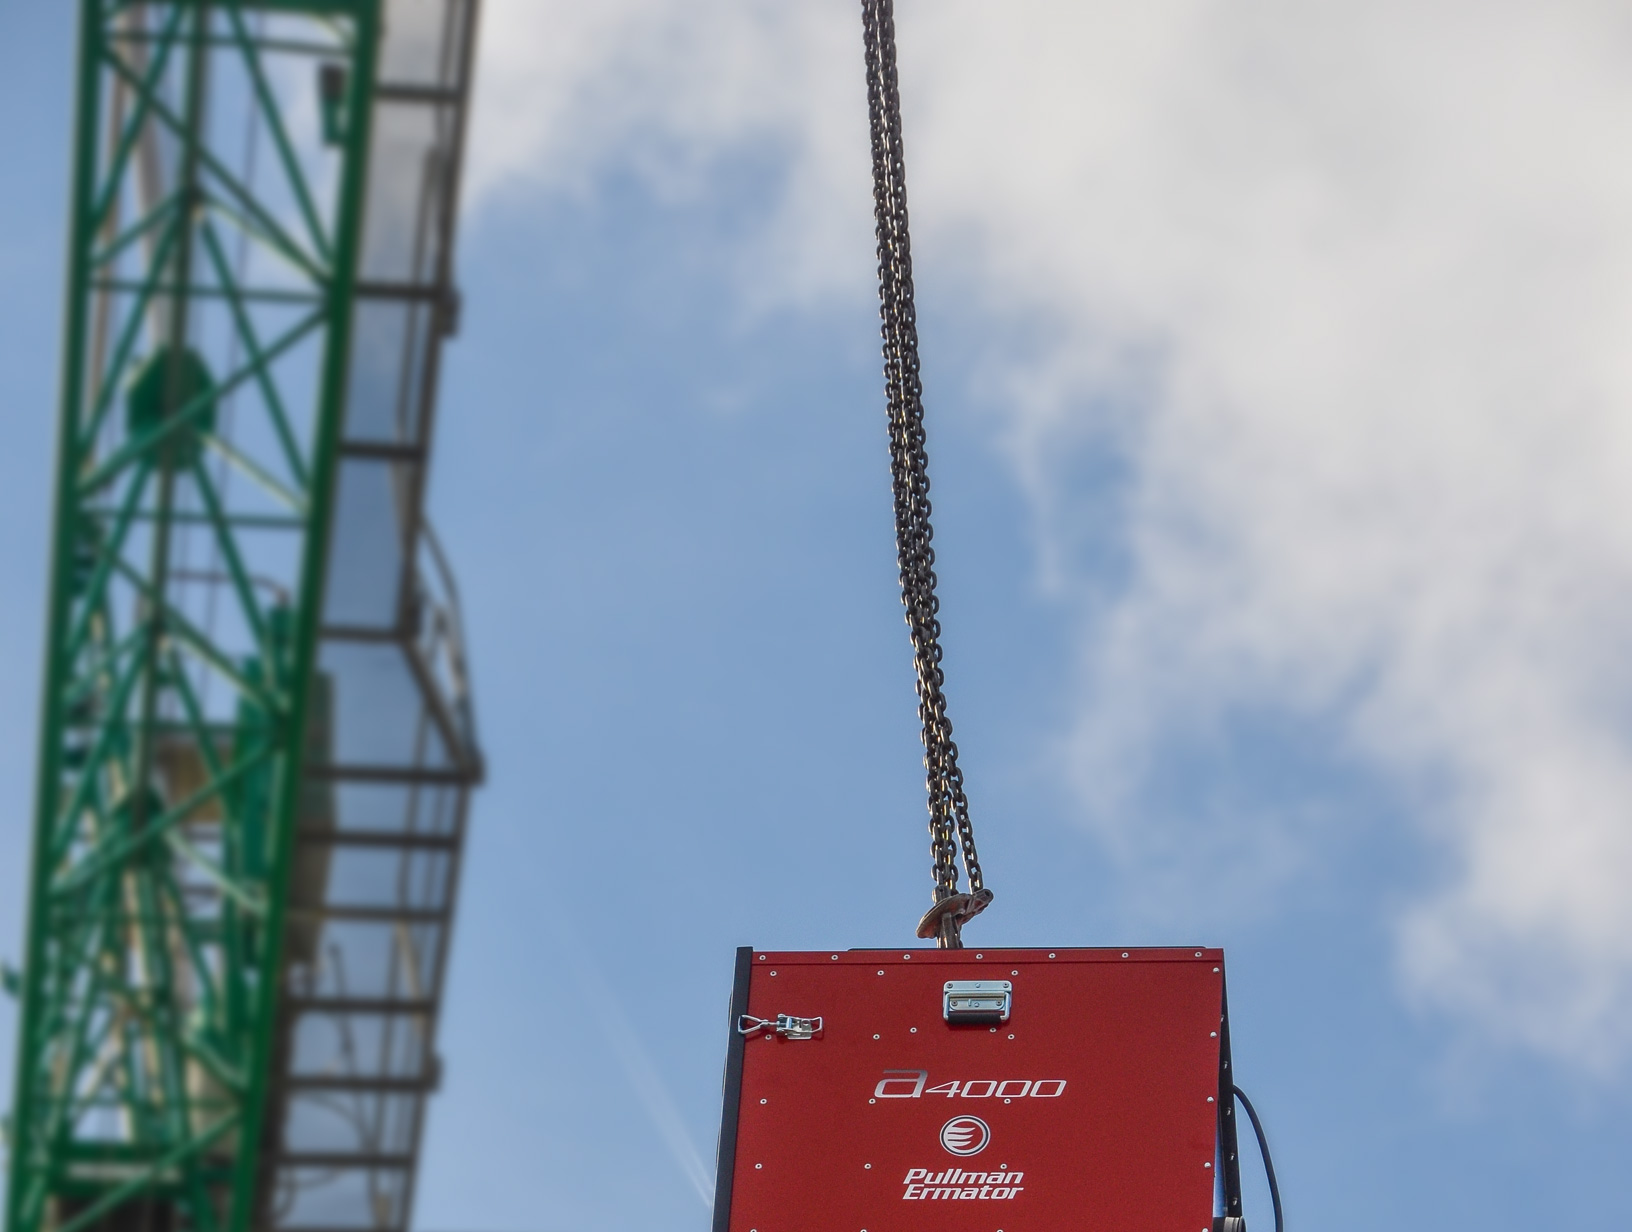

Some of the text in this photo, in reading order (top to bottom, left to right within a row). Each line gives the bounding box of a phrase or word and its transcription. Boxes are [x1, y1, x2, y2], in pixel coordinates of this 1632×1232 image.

[873, 1069, 1068, 1099] a4000
[902, 1168, 1025, 1185] Pullman
[902, 1184, 1025, 1200] Ermator
